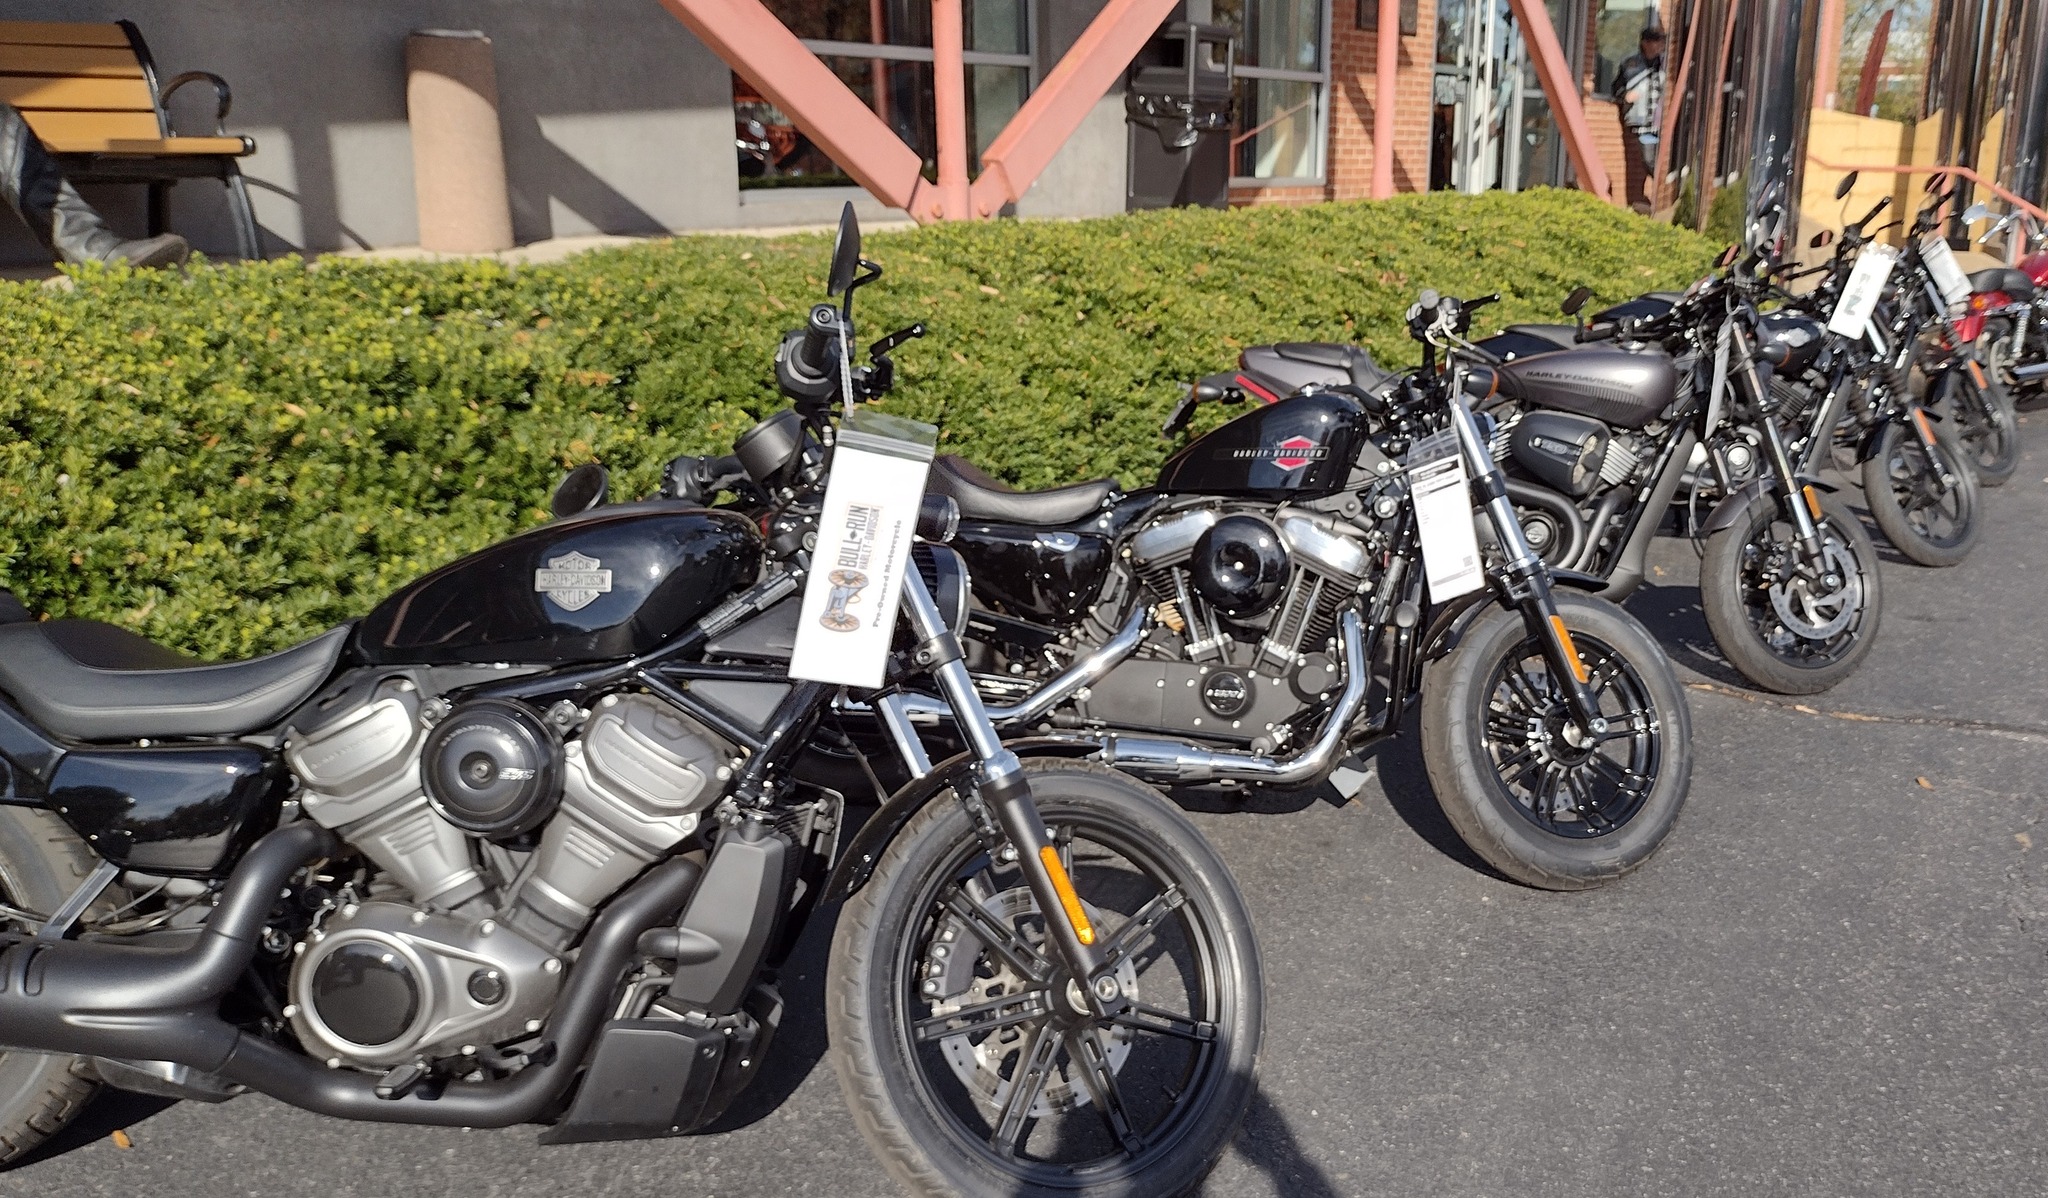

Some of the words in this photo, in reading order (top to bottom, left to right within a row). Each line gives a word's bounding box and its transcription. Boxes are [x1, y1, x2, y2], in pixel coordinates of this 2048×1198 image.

[1526, 370, 1633, 390] HARLEY-DAVIDSON
[846, 505, 869, 531] RUN
[838, 537, 862, 569] BULL
[859, 507, 880, 570] HARLEY-DAVIDSON
[873, 575, 889, 627] Pre-Owned
[885, 520, 901, 573] Motorcycle
